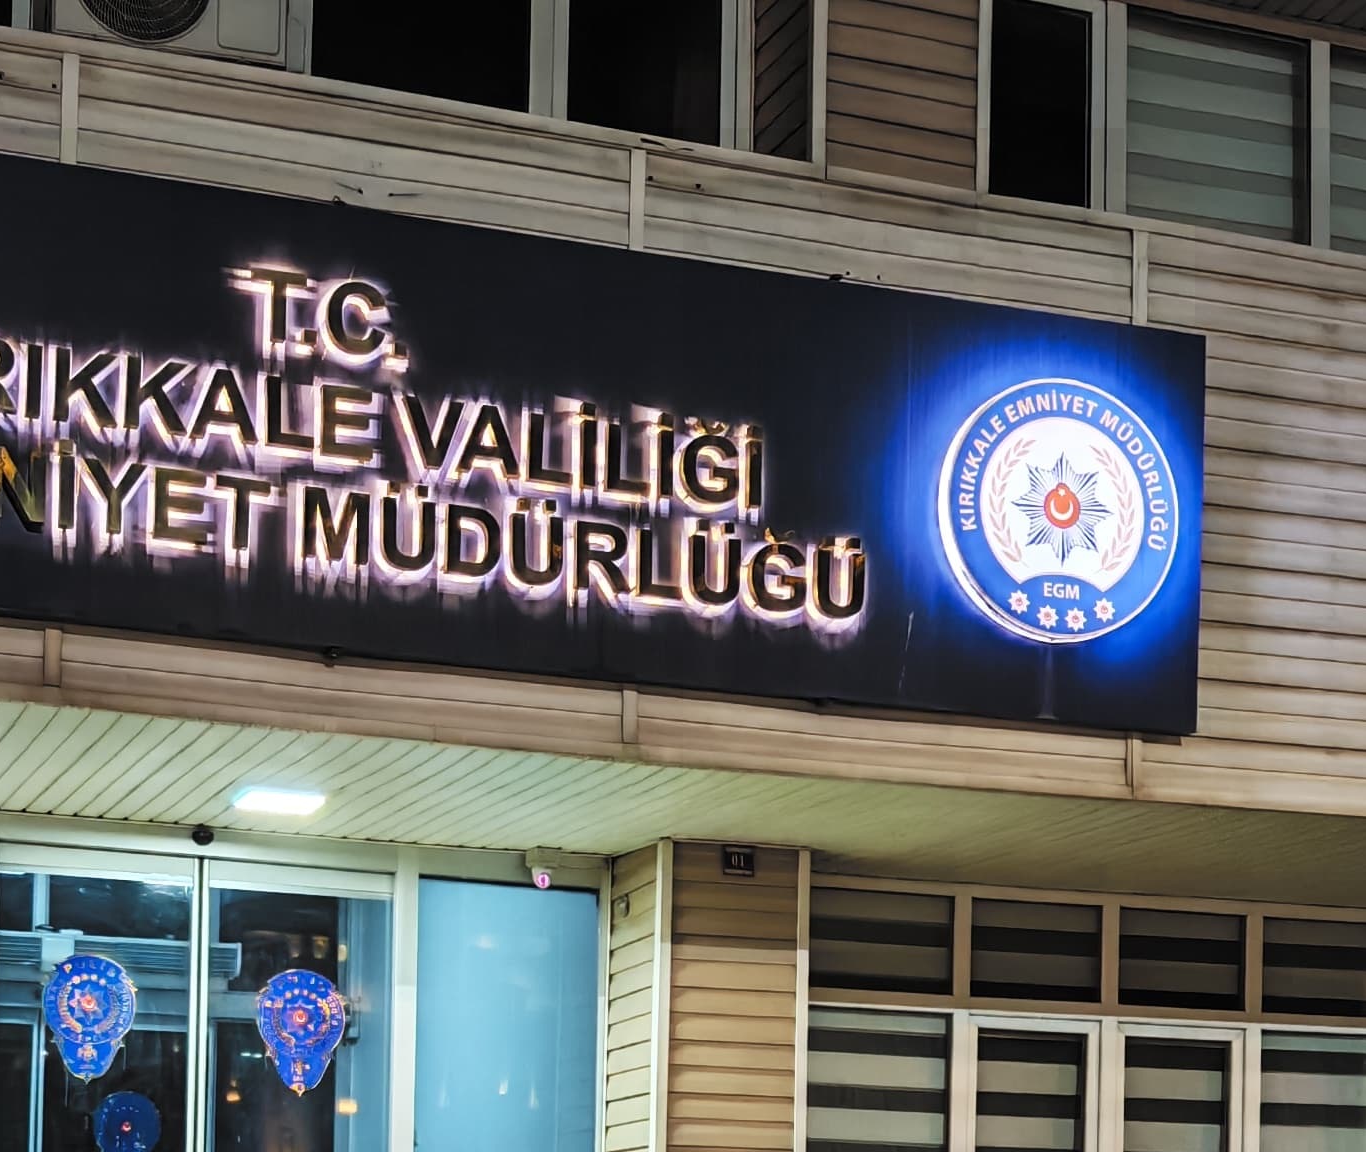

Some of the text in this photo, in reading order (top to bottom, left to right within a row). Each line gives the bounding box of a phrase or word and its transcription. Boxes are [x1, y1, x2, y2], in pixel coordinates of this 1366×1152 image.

[245, 265, 408, 368] T.C.
[397, 390, 766, 511] VALİLİĞİ
[959, 389, 1170, 552] KIRIKKALE EMNİYET MÜDÜRLÜĞÜ
[300, 482, 868, 620] MÜDÜRLÜĞÜ
[1042, 582, 1081, 600] EGM
